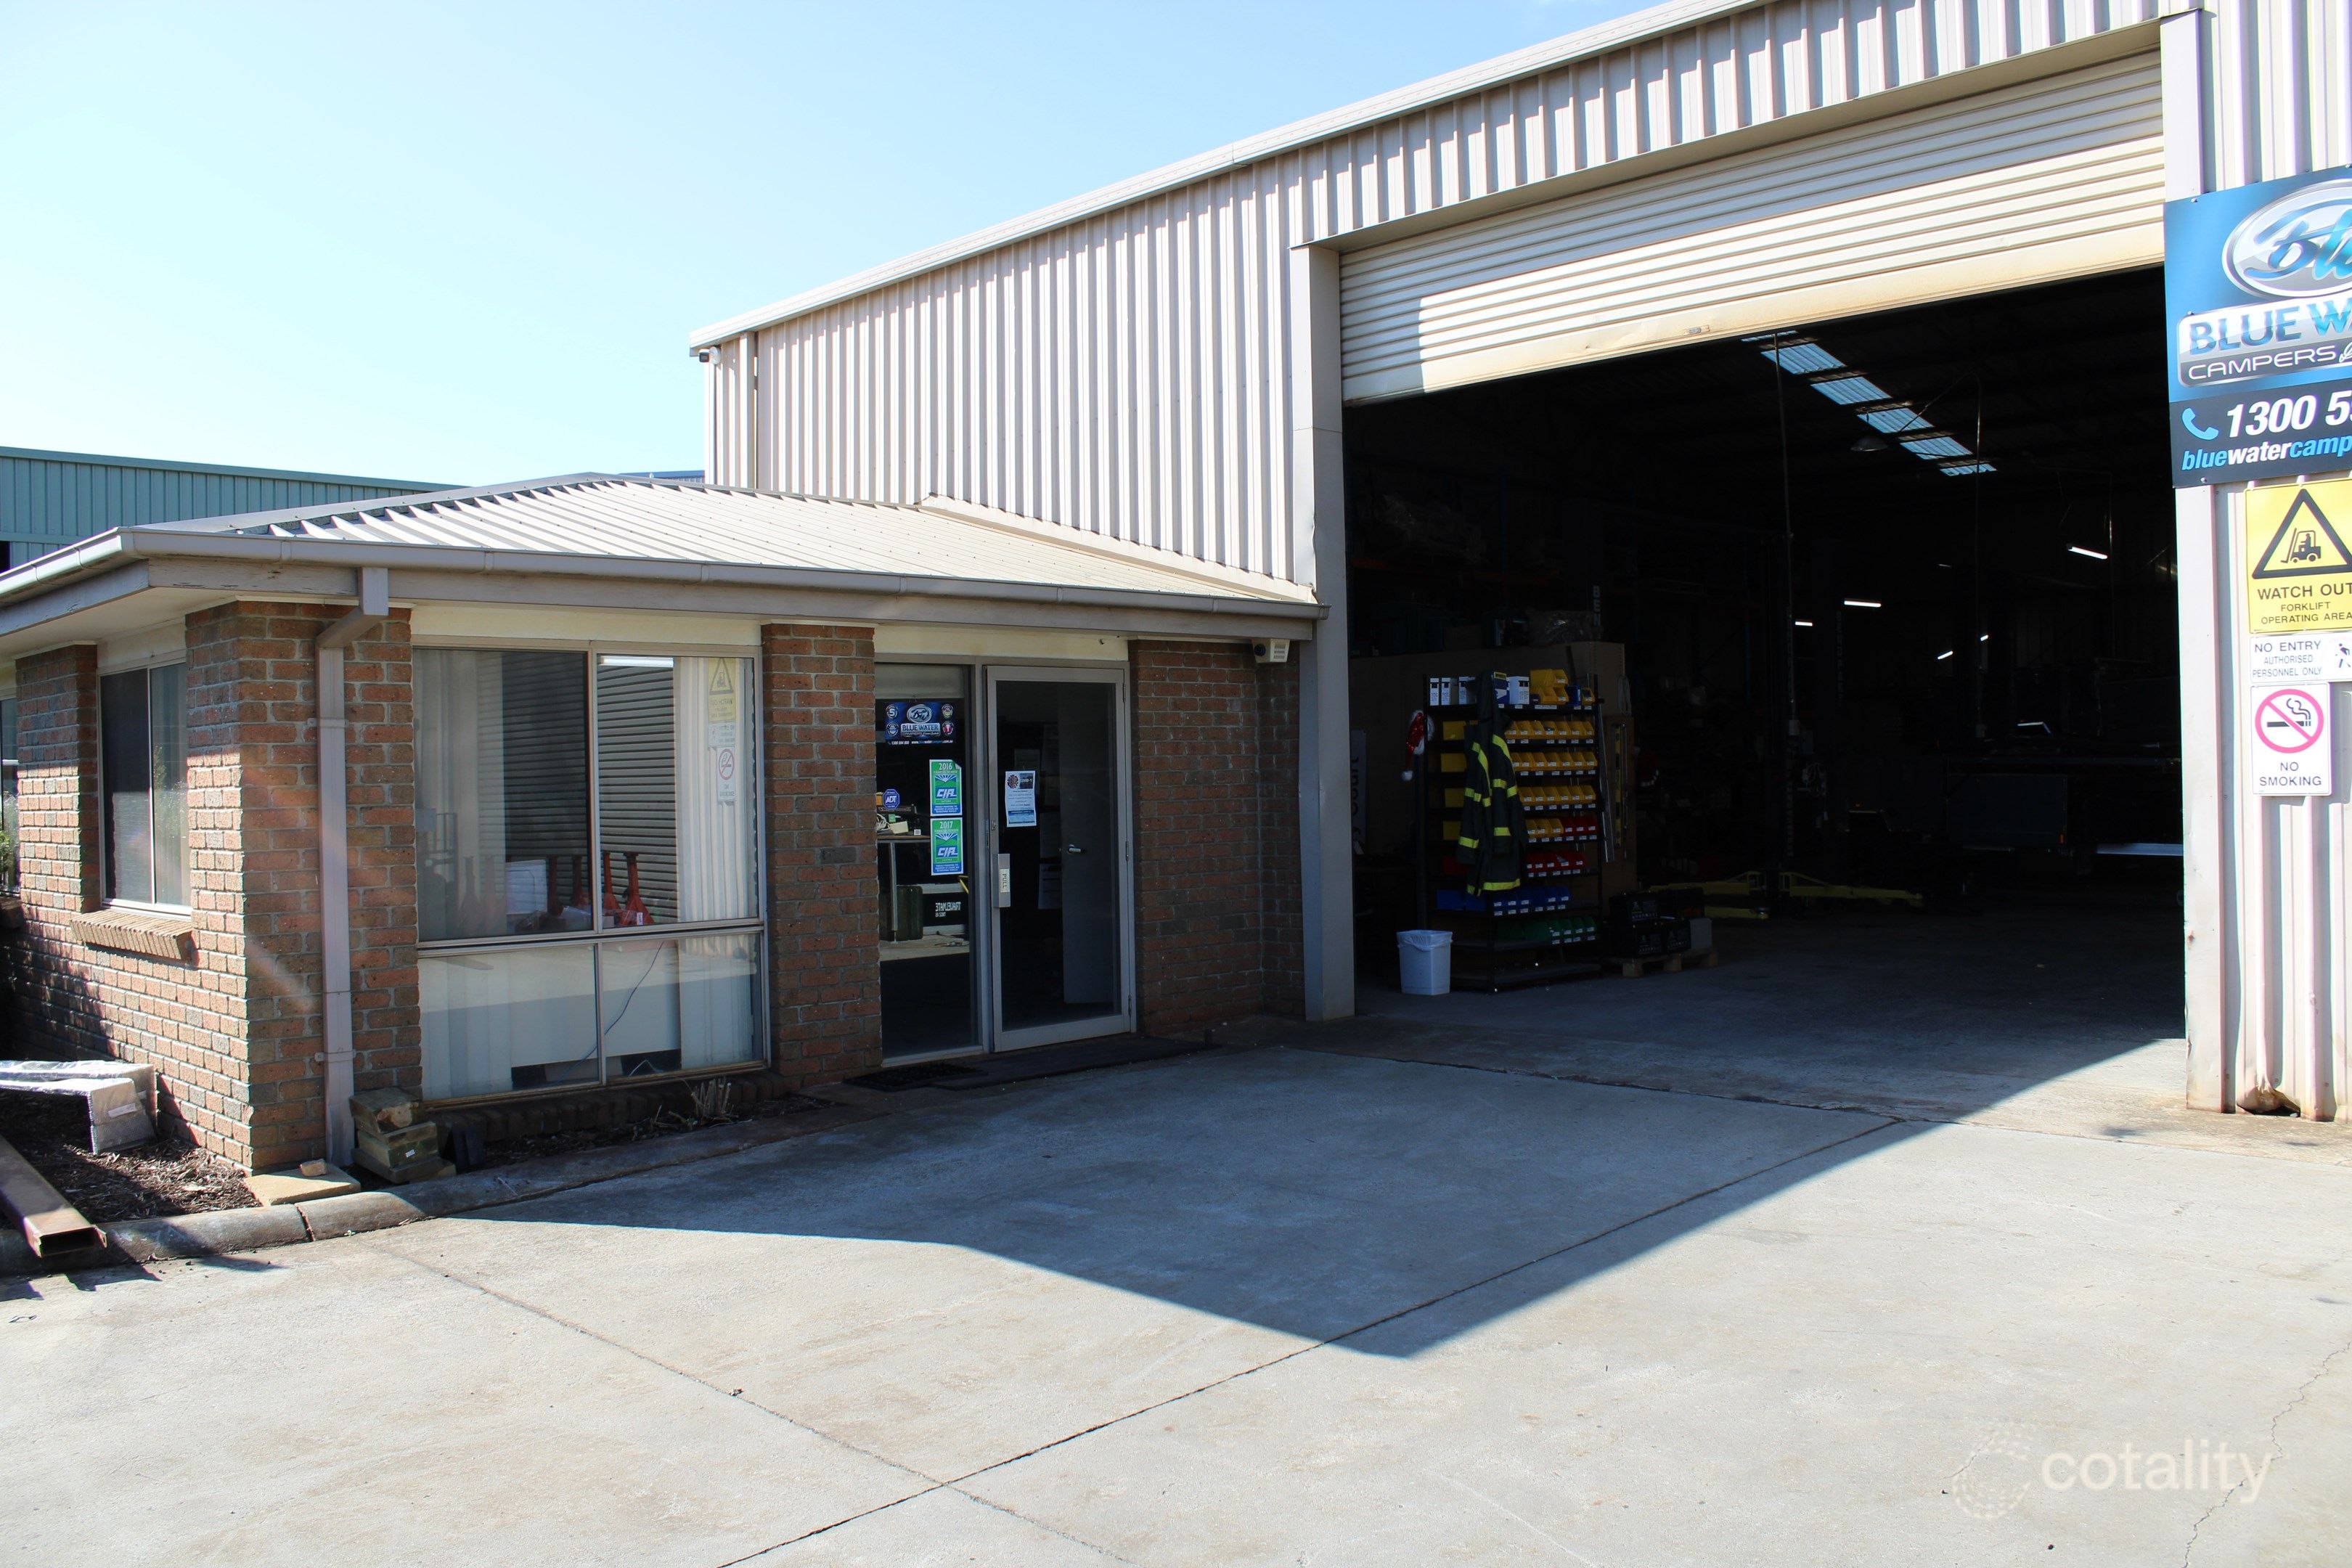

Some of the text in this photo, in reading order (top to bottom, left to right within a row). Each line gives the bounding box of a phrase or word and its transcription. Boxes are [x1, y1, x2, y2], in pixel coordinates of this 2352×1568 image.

[2189, 306, 2301, 355] BLUE
[2307, 297, 2352, 337] W
[2189, 345, 2336, 380] CAMPERS
[2227, 390, 2352, 438] 1300 5
[2258, 583, 2352, 600] WATCH OUT
[2281, 602, 2330, 611] FORKLIFT
[2261, 612, 2352, 624] OPERATING AREA
[2255, 641, 2322, 653] NO ENTRY
[2264, 655, 2314, 664] AUTHORISED
[2253, 667, 2322, 677] PERSONNEL ONLY
[2280, 762, 2298, 771] NO
[2260, 776, 2322, 786] SMOKING
